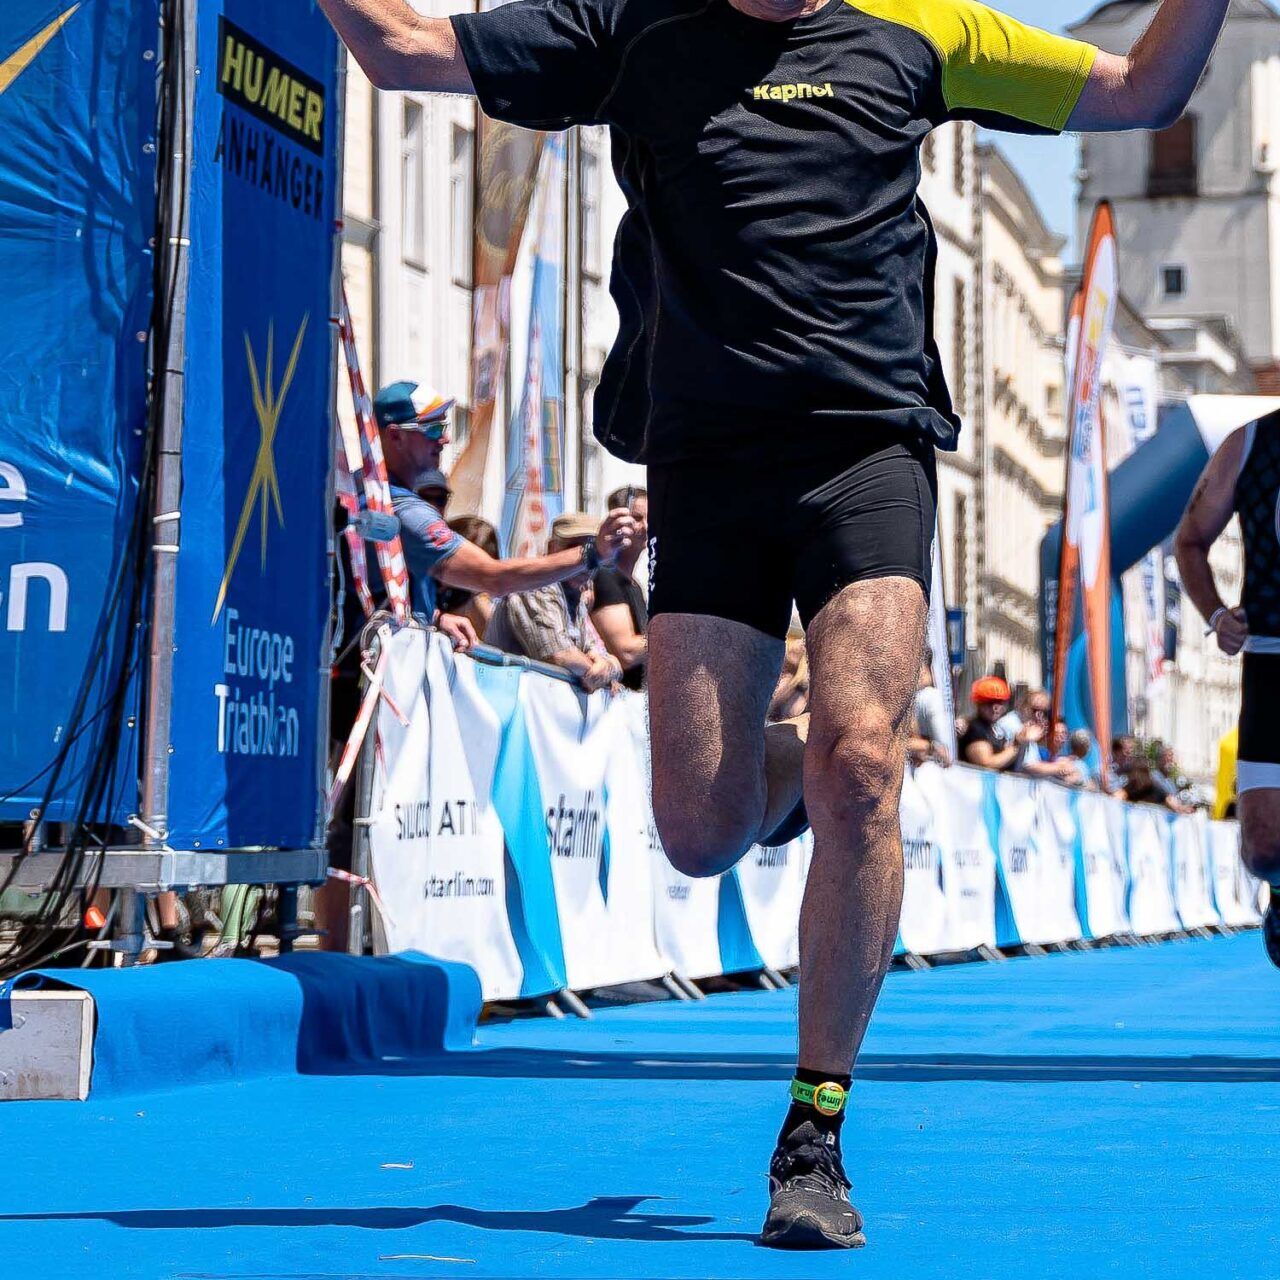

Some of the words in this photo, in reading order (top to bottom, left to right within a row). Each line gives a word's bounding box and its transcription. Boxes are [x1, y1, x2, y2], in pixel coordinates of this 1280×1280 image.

[221, 35, 325, 142] HUMER
[224, 607, 295, 691] Europe
[214, 683, 300, 758] Triathlon
